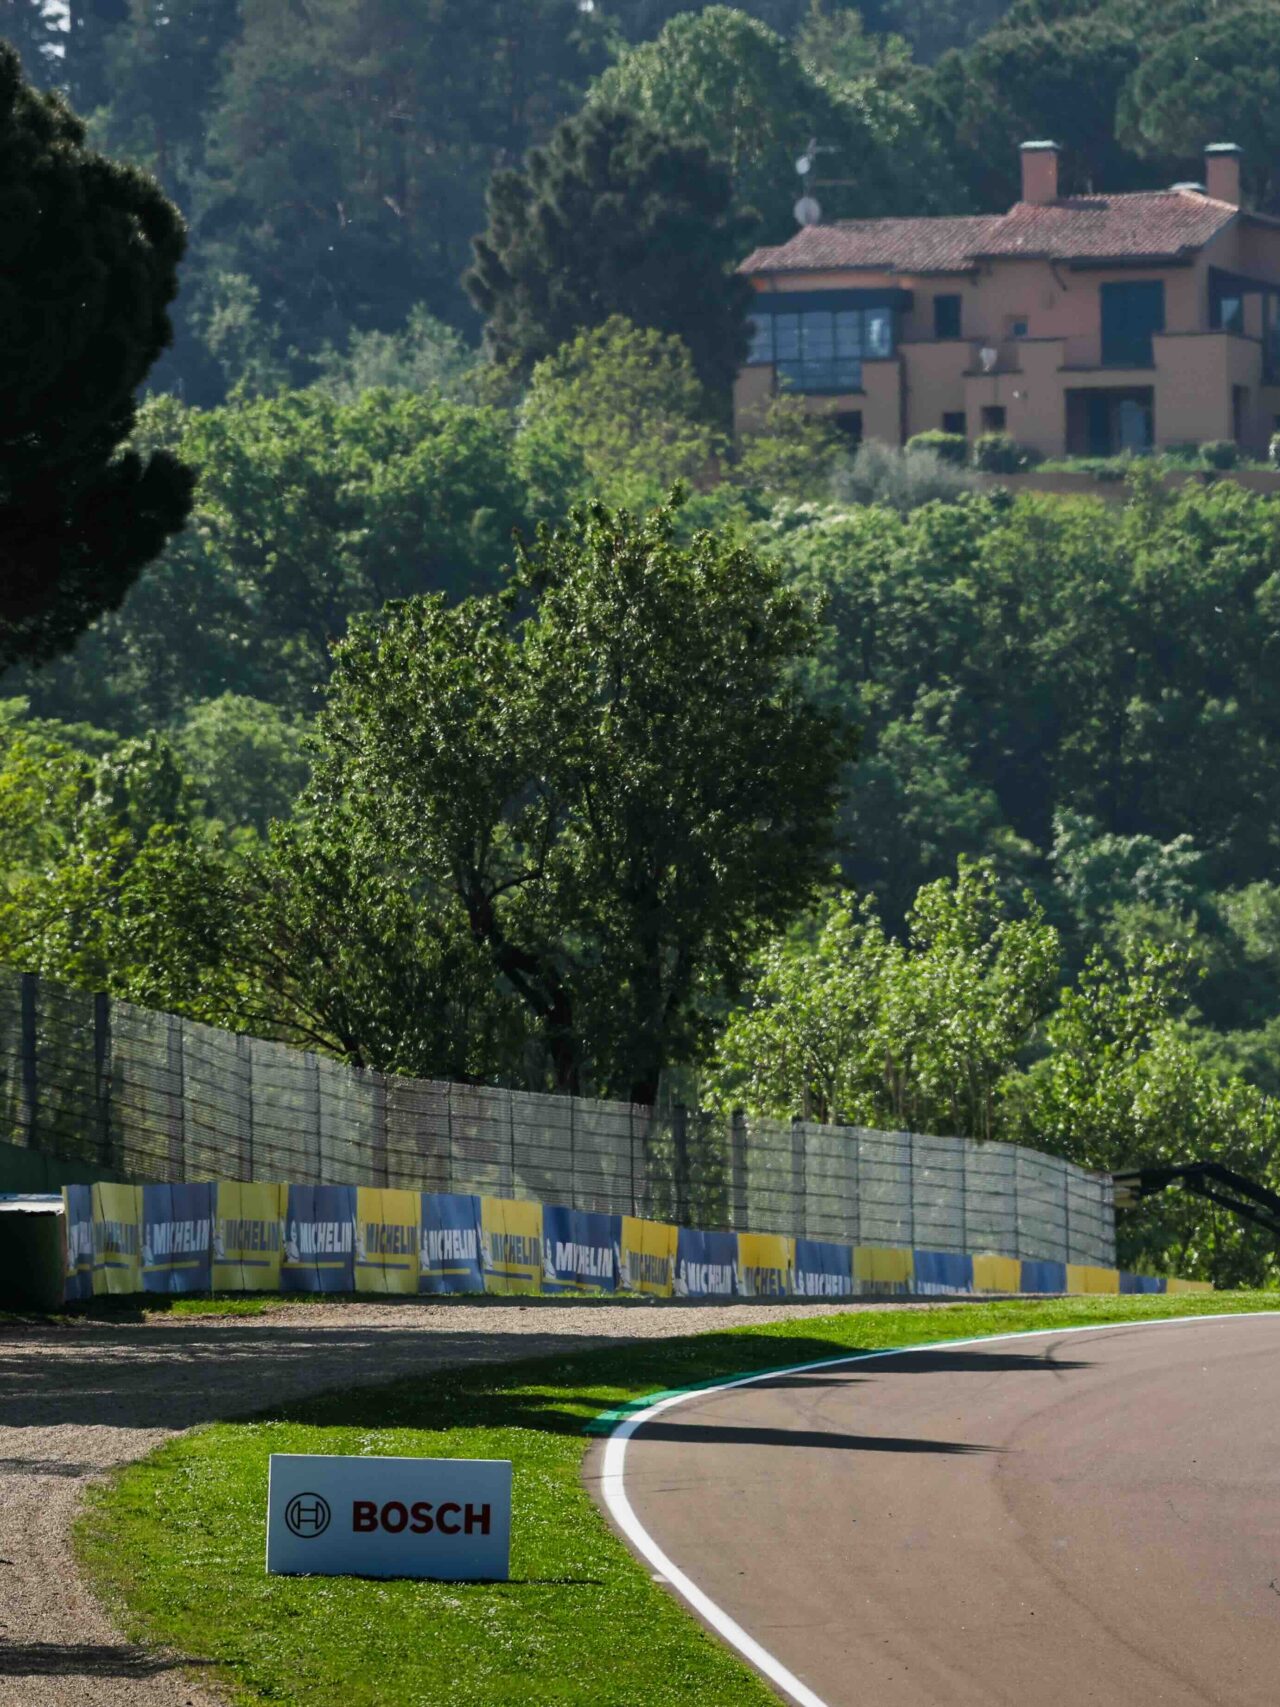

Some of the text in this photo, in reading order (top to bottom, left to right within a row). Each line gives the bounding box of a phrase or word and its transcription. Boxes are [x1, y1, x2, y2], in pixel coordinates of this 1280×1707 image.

[153, 1219, 210, 1255] MICHELIN
[225, 1219, 279, 1251] MICHELIN
[300, 1222, 352, 1253] MICHELIN
[366, 1223, 417, 1255] MICHELIN
[429, 1229, 477, 1260] MICHELIN
[491, 1232, 540, 1266] MICHELIN
[556, 1241, 613, 1278] MIHELIN
[352, 1501, 491, 1535] BOSCH
